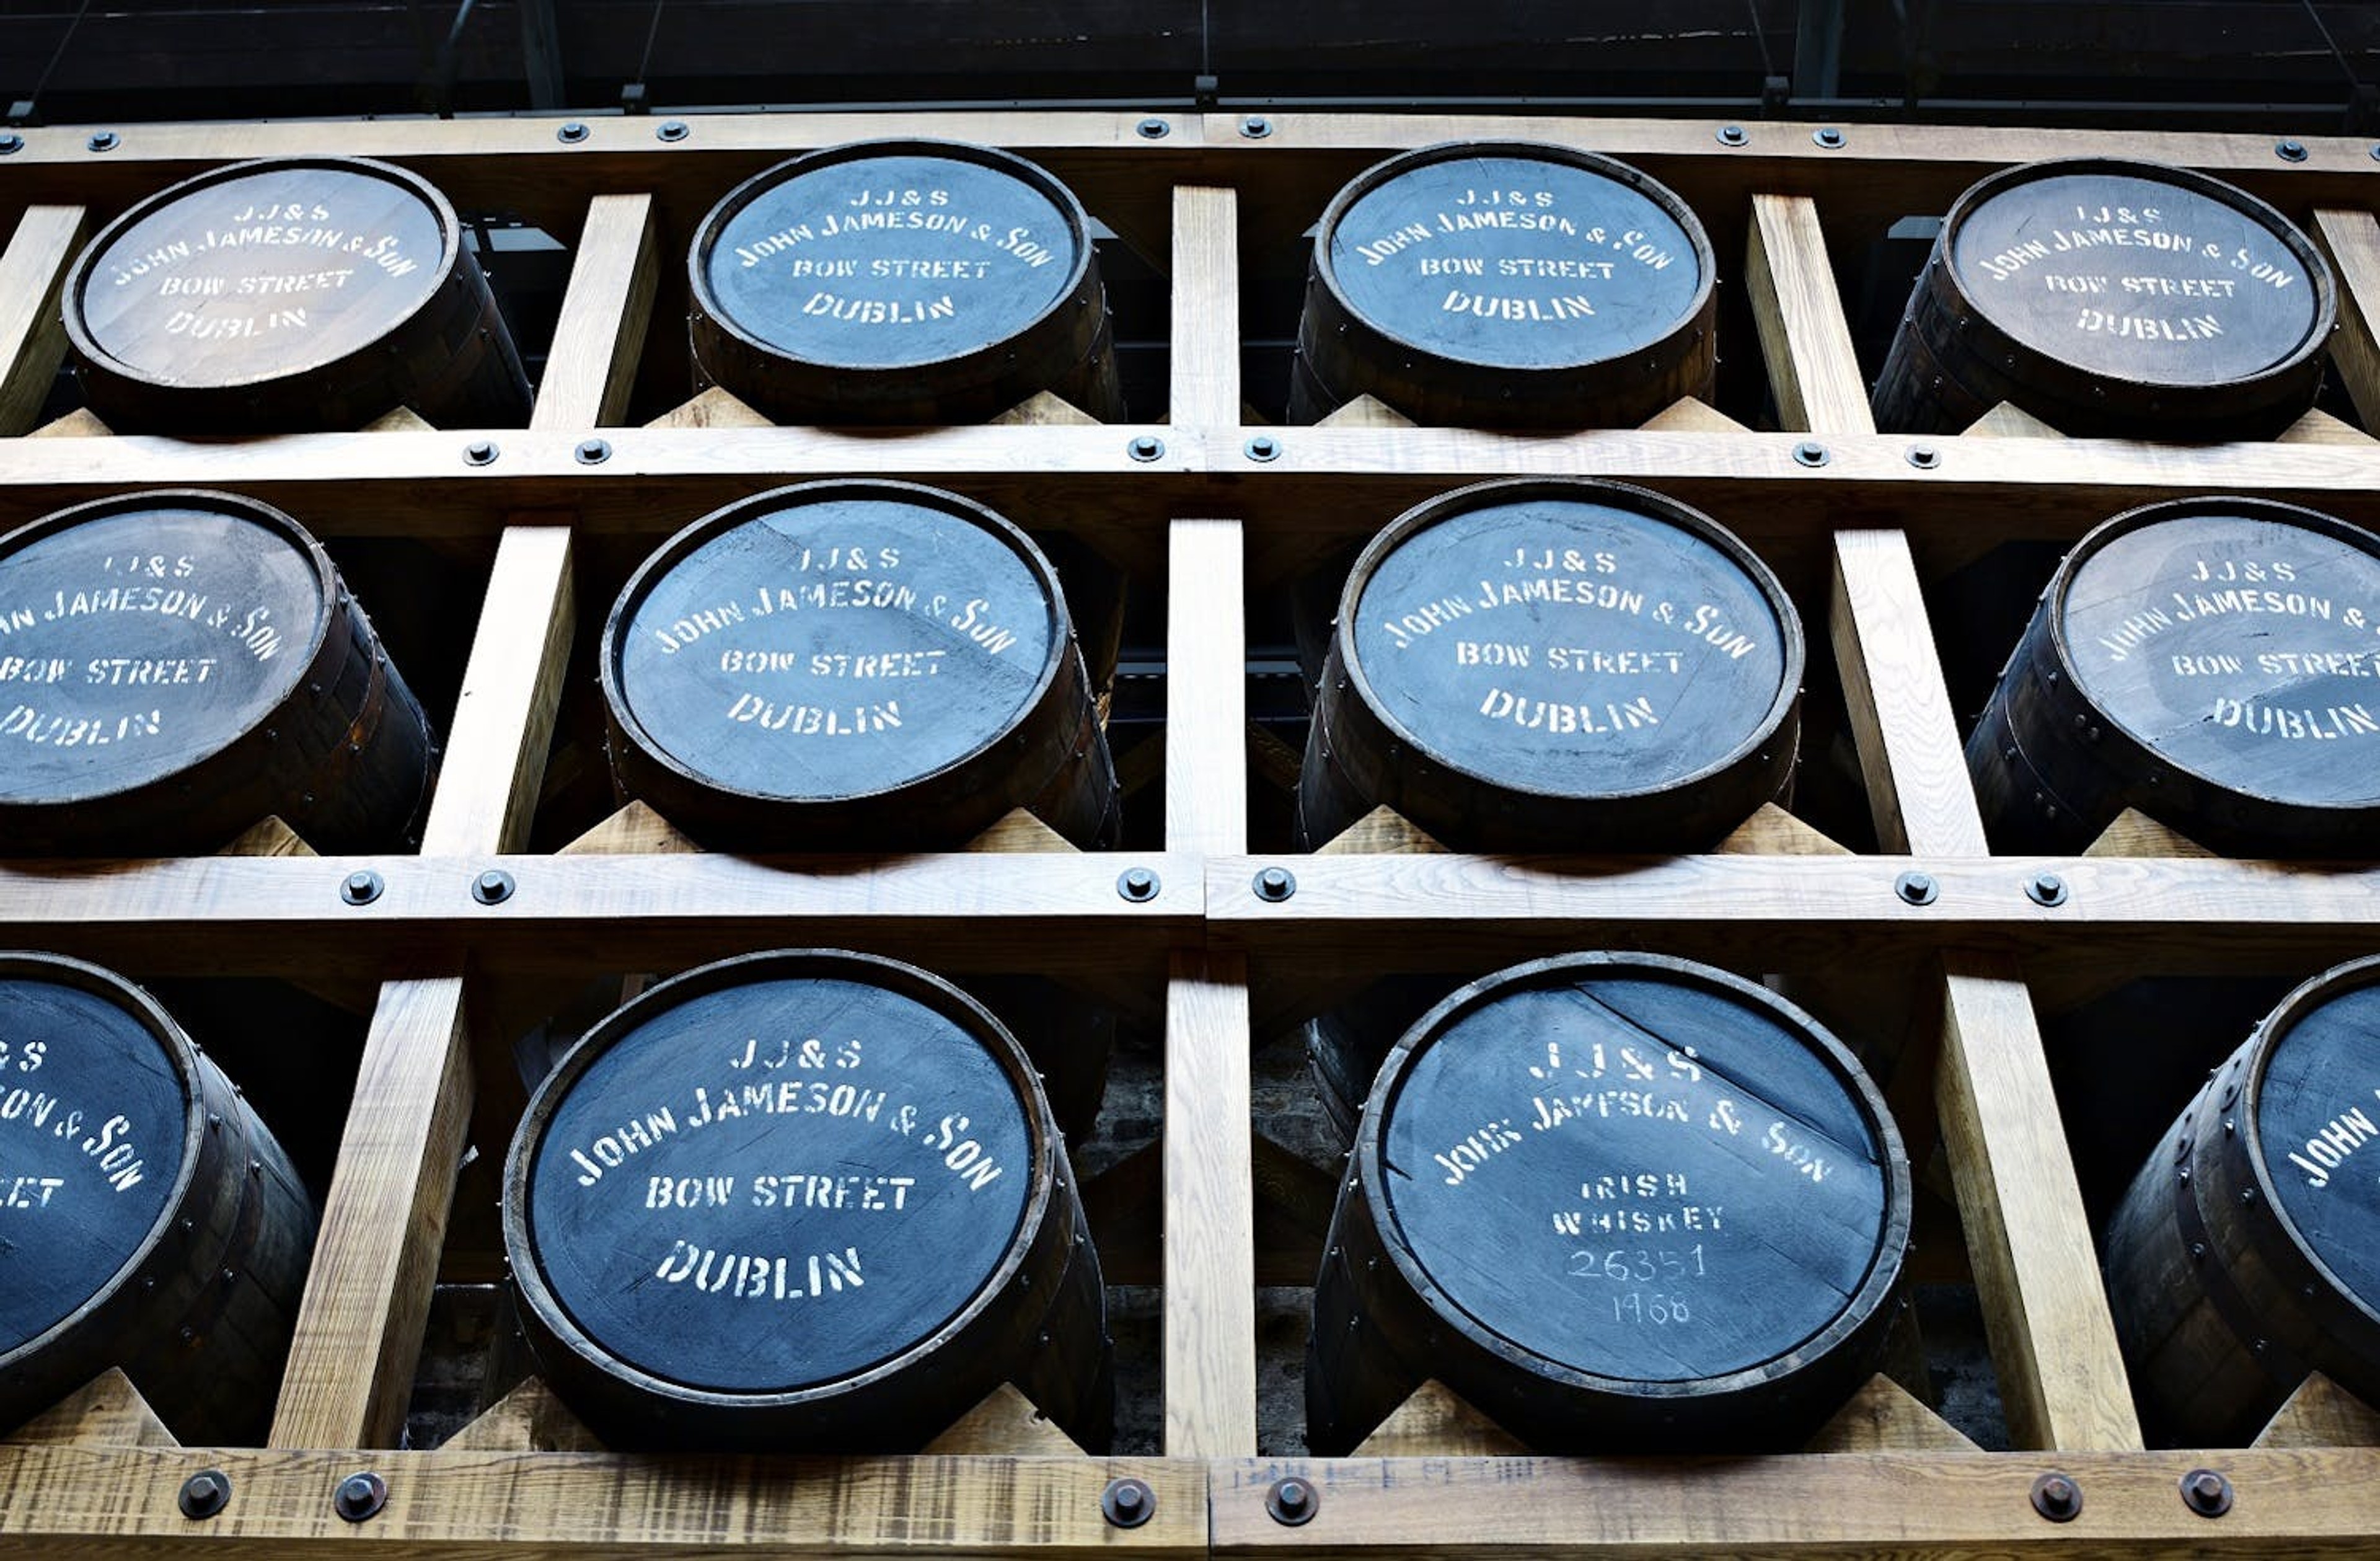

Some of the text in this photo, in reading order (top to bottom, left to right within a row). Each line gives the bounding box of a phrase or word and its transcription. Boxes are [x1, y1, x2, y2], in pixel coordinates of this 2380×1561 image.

[111, 226, 418, 286] JOHN JAMESON & SON
[735, 212, 1054, 268] JOHN JAMESON & SON
[1356, 211, 1674, 271] JOHN JAMESON & SON
[1979, 229, 2294, 290] JOHN JAMESON & SON
[160, 269, 354, 295] BOW STREET
[793, 260, 990, 278] BOW STREET
[1421, 259, 1615, 279] BOW STREET
[2045, 275, 2235, 298] BOW STREET
[164, 307, 307, 338] DUBLIN
[803, 292, 954, 324] DUBLIN
[1442, 290, 1595, 321] DUBLIN
[2076, 308, 2224, 341] DUBLIN
[44, 587, 208, 619] JAMESON
[207, 603, 232, 629] &
[231, 605, 283, 662] SON
[655, 580, 1017, 655] JOHN JAMESON & SON
[1384, 578, 1756, 660] JOHN JAMESON & SON
[2097, 590, 2366, 662] JOHN JAMESON &
[0, 656, 217, 686] BOW STREET
[720, 648, 946, 678] BOW STREET
[1456, 642, 1683, 674] BOW STREET
[2171, 655, 2244, 676] BOW
[0, 705, 161, 746] DUBLIN
[726, 692, 902, 736] DUBLIN
[1480, 688, 1659, 734] DUBLIN
[2213, 697, 2379, 740] DUBLIN
[0, 1085, 145, 1192] ON & SON
[569, 1081, 1003, 1193] JOHN JAMESON & SON
[1434, 1090, 1834, 1186] JOHN JAMESON & SON
[2288, 1107, 2379, 1187] JOHN
[0, 1177, 64, 1208] ET
[646, 1175, 916, 1210] BOW STREET
[1582, 1174, 1687, 1200] IRISH
[1553, 1206, 1723, 1236] WHISKEY
[656, 1239, 865, 1301] DUBLIN
